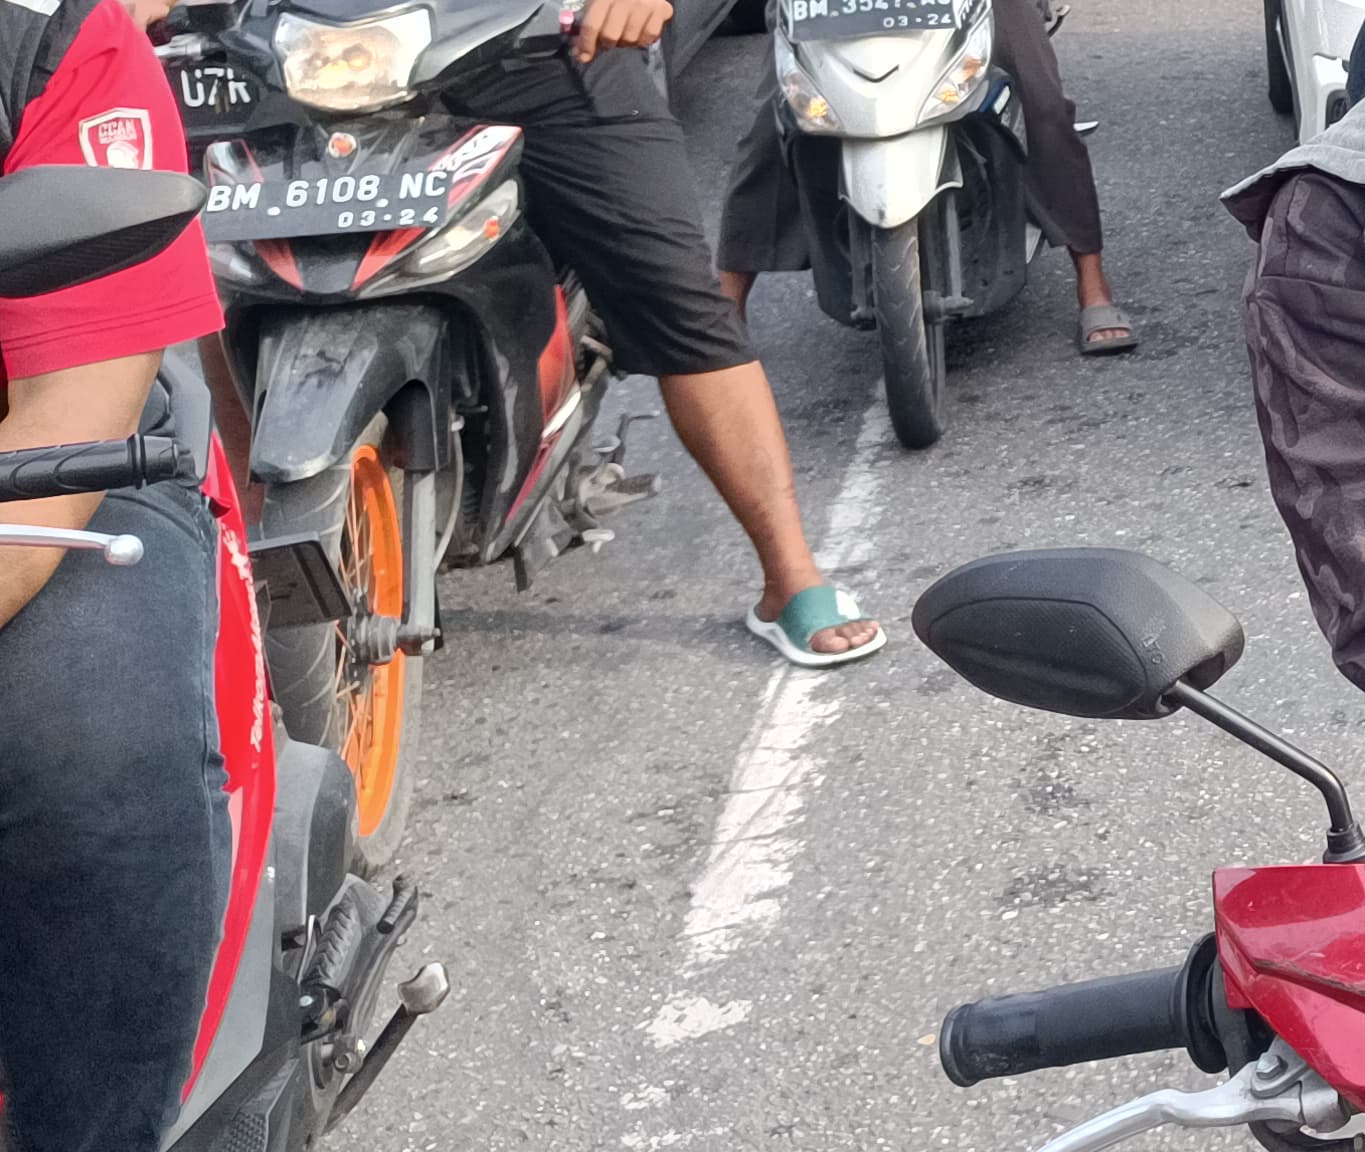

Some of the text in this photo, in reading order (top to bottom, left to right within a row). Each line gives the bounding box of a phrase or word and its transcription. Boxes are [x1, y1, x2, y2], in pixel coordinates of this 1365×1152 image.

[206, 171, 447, 212] BM 6108 NC
